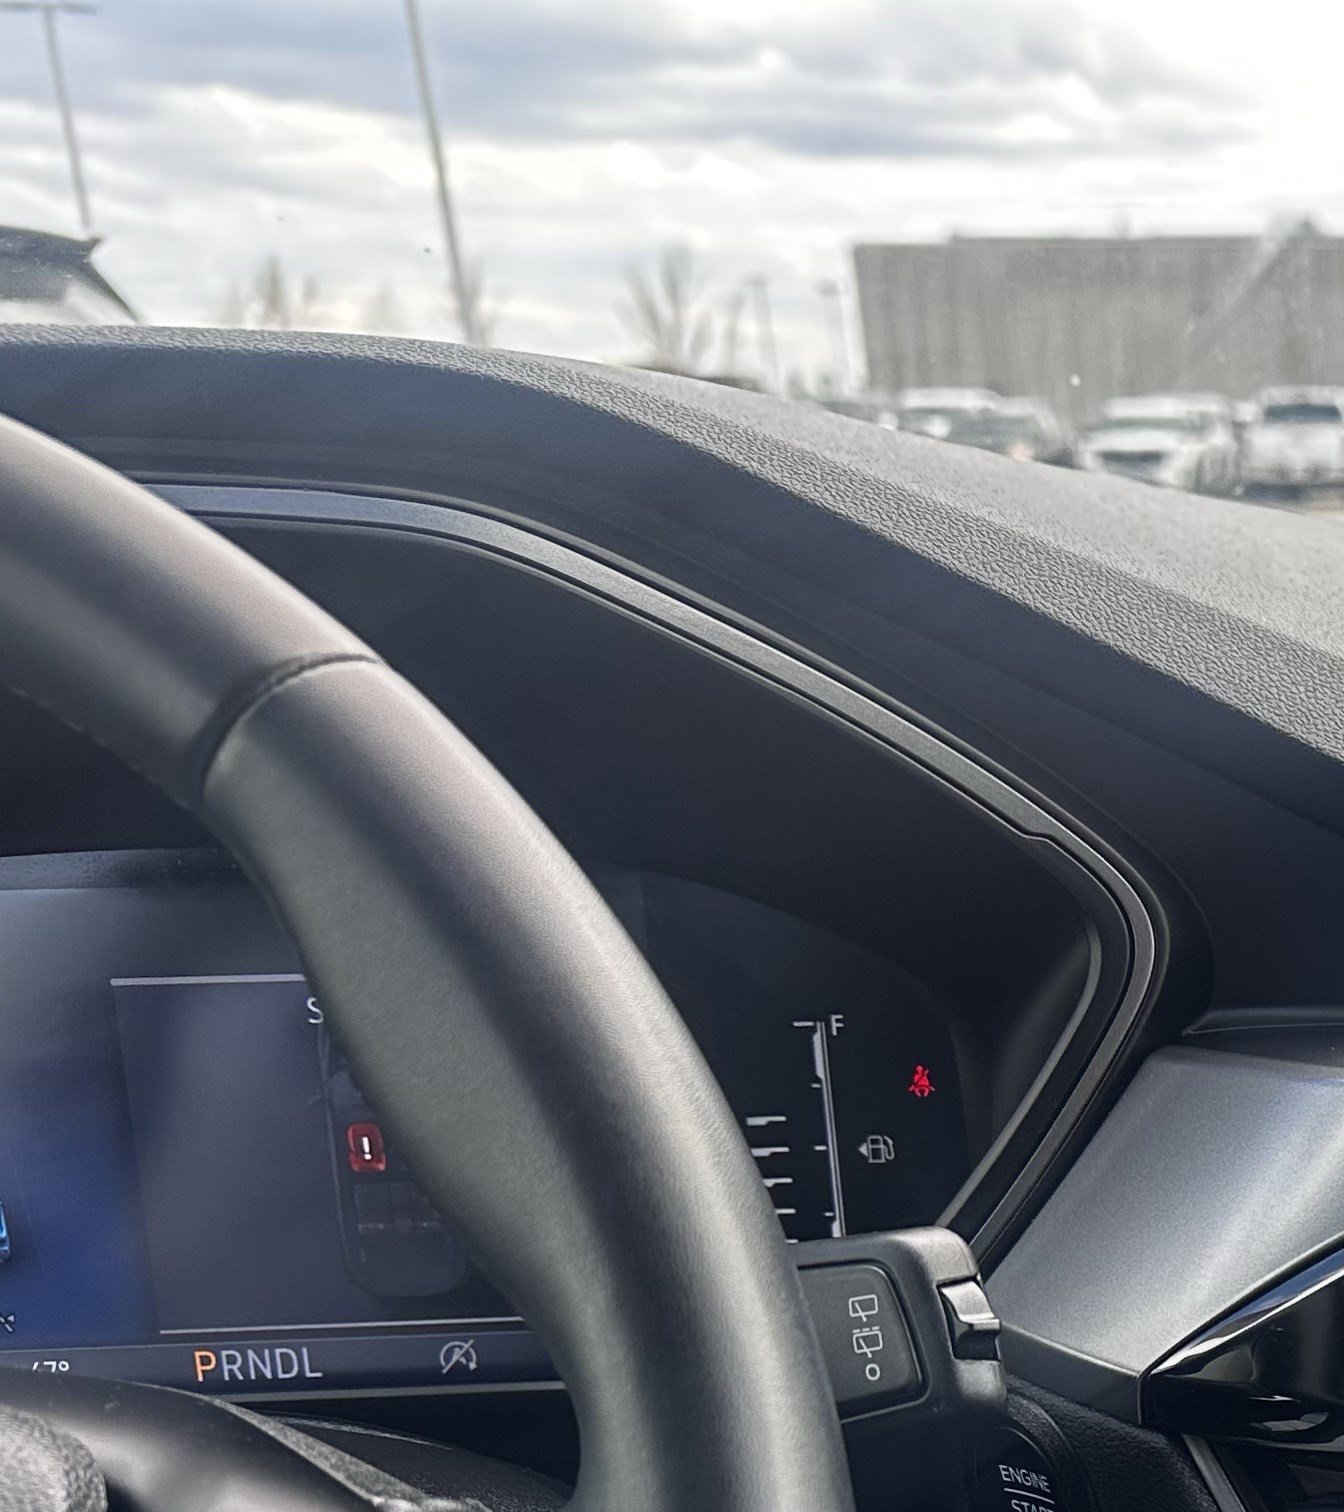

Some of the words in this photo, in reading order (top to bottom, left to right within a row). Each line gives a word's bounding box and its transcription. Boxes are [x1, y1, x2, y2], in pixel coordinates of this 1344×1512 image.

[830, 1014, 844, 1036] F
[193, 1346, 324, 1383] PRNDL
[998, 1464, 1052, 1493] ENGINE
